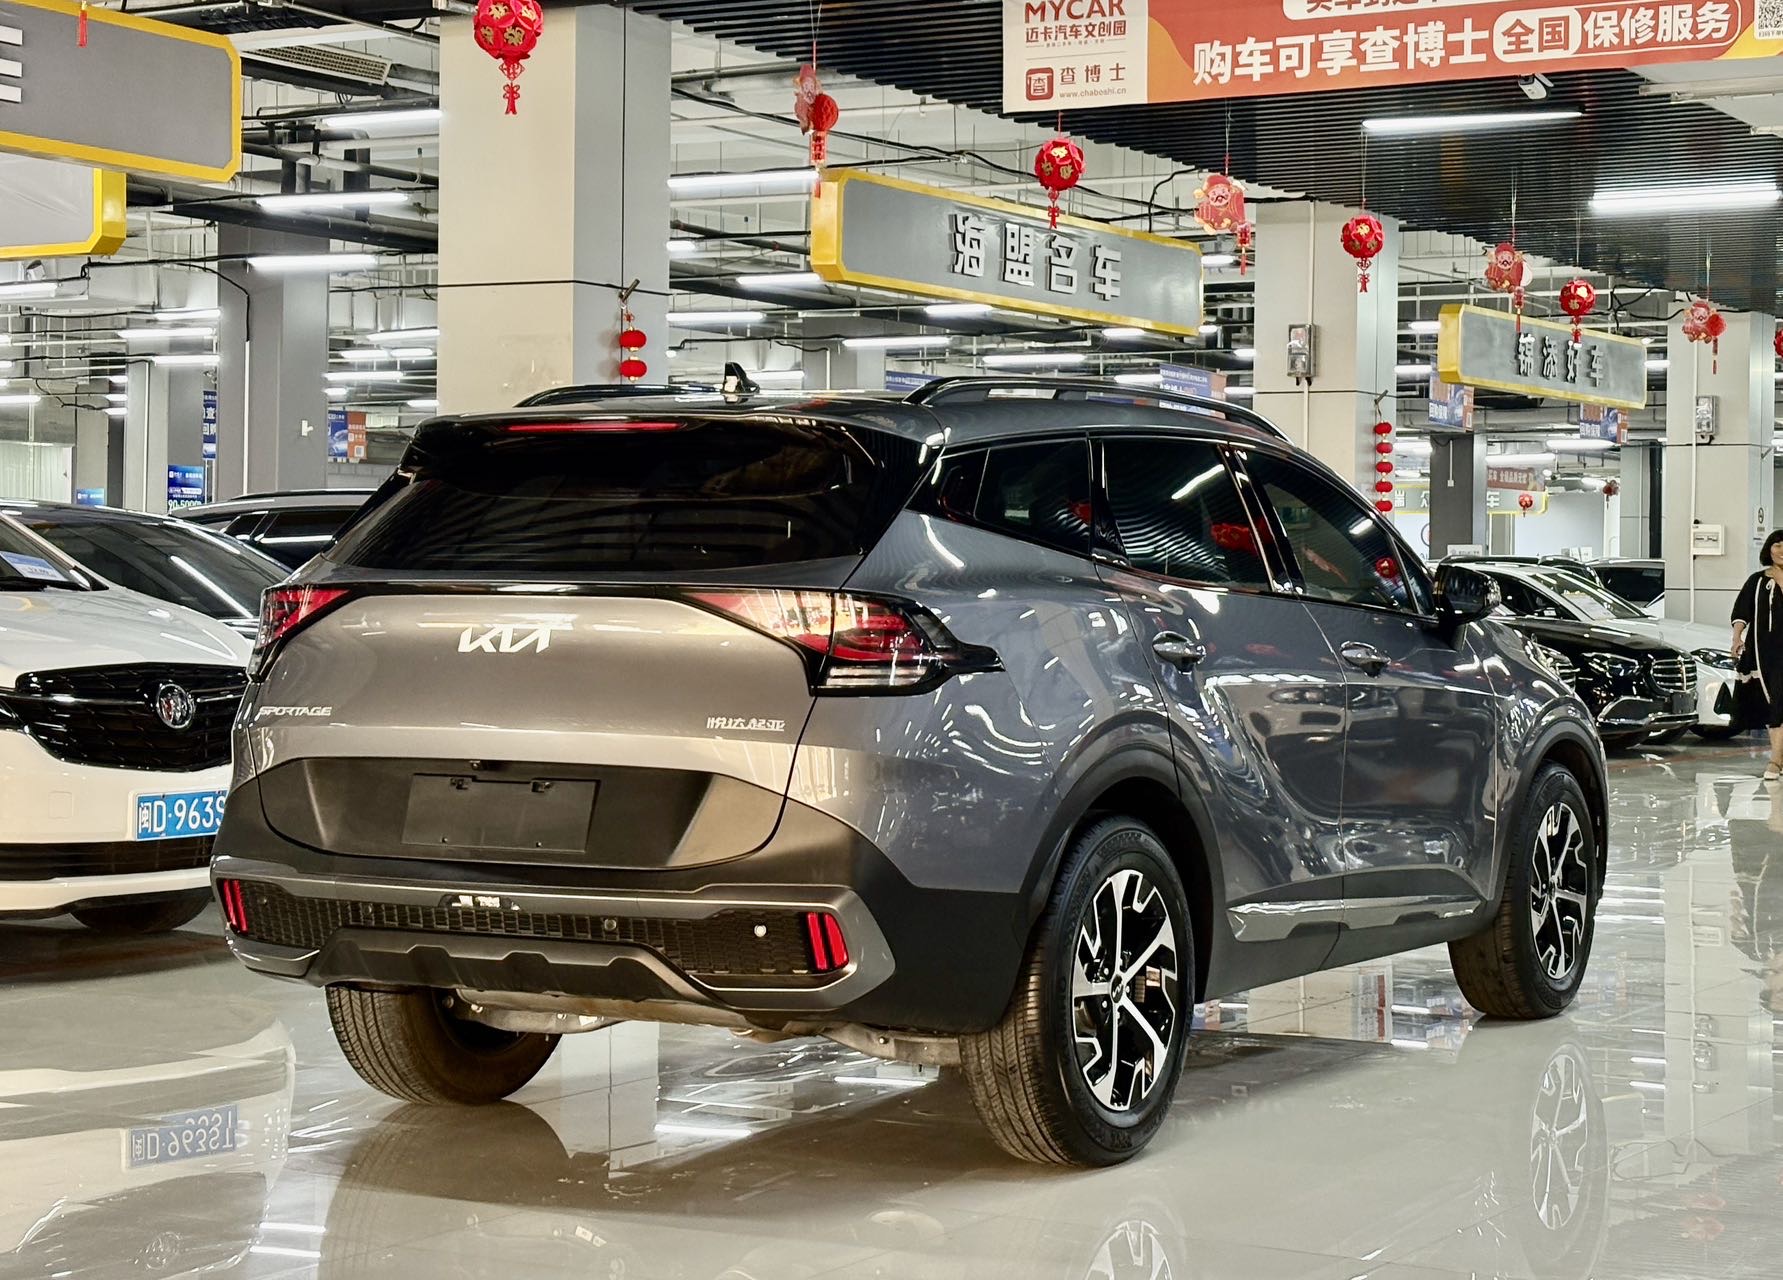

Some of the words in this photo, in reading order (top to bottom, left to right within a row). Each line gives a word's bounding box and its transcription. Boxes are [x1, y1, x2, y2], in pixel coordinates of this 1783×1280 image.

[1025, 0, 1126, 24] MYCAR
[1025, 20, 1127, 44] 迈卡汽车文创园
[1193, 18, 1490, 86] 购车可享查博士
[1501, 15, 1572, 55] 全国
[1584, 2, 1732, 49] 保修服务
[1060, 87, 1127, 98] www.chaboshi.cn
[952, 213, 1122, 301] 海盟名车
[457, 624, 553, 654] KIA
[259, 705, 333, 717] SPORTAGE
